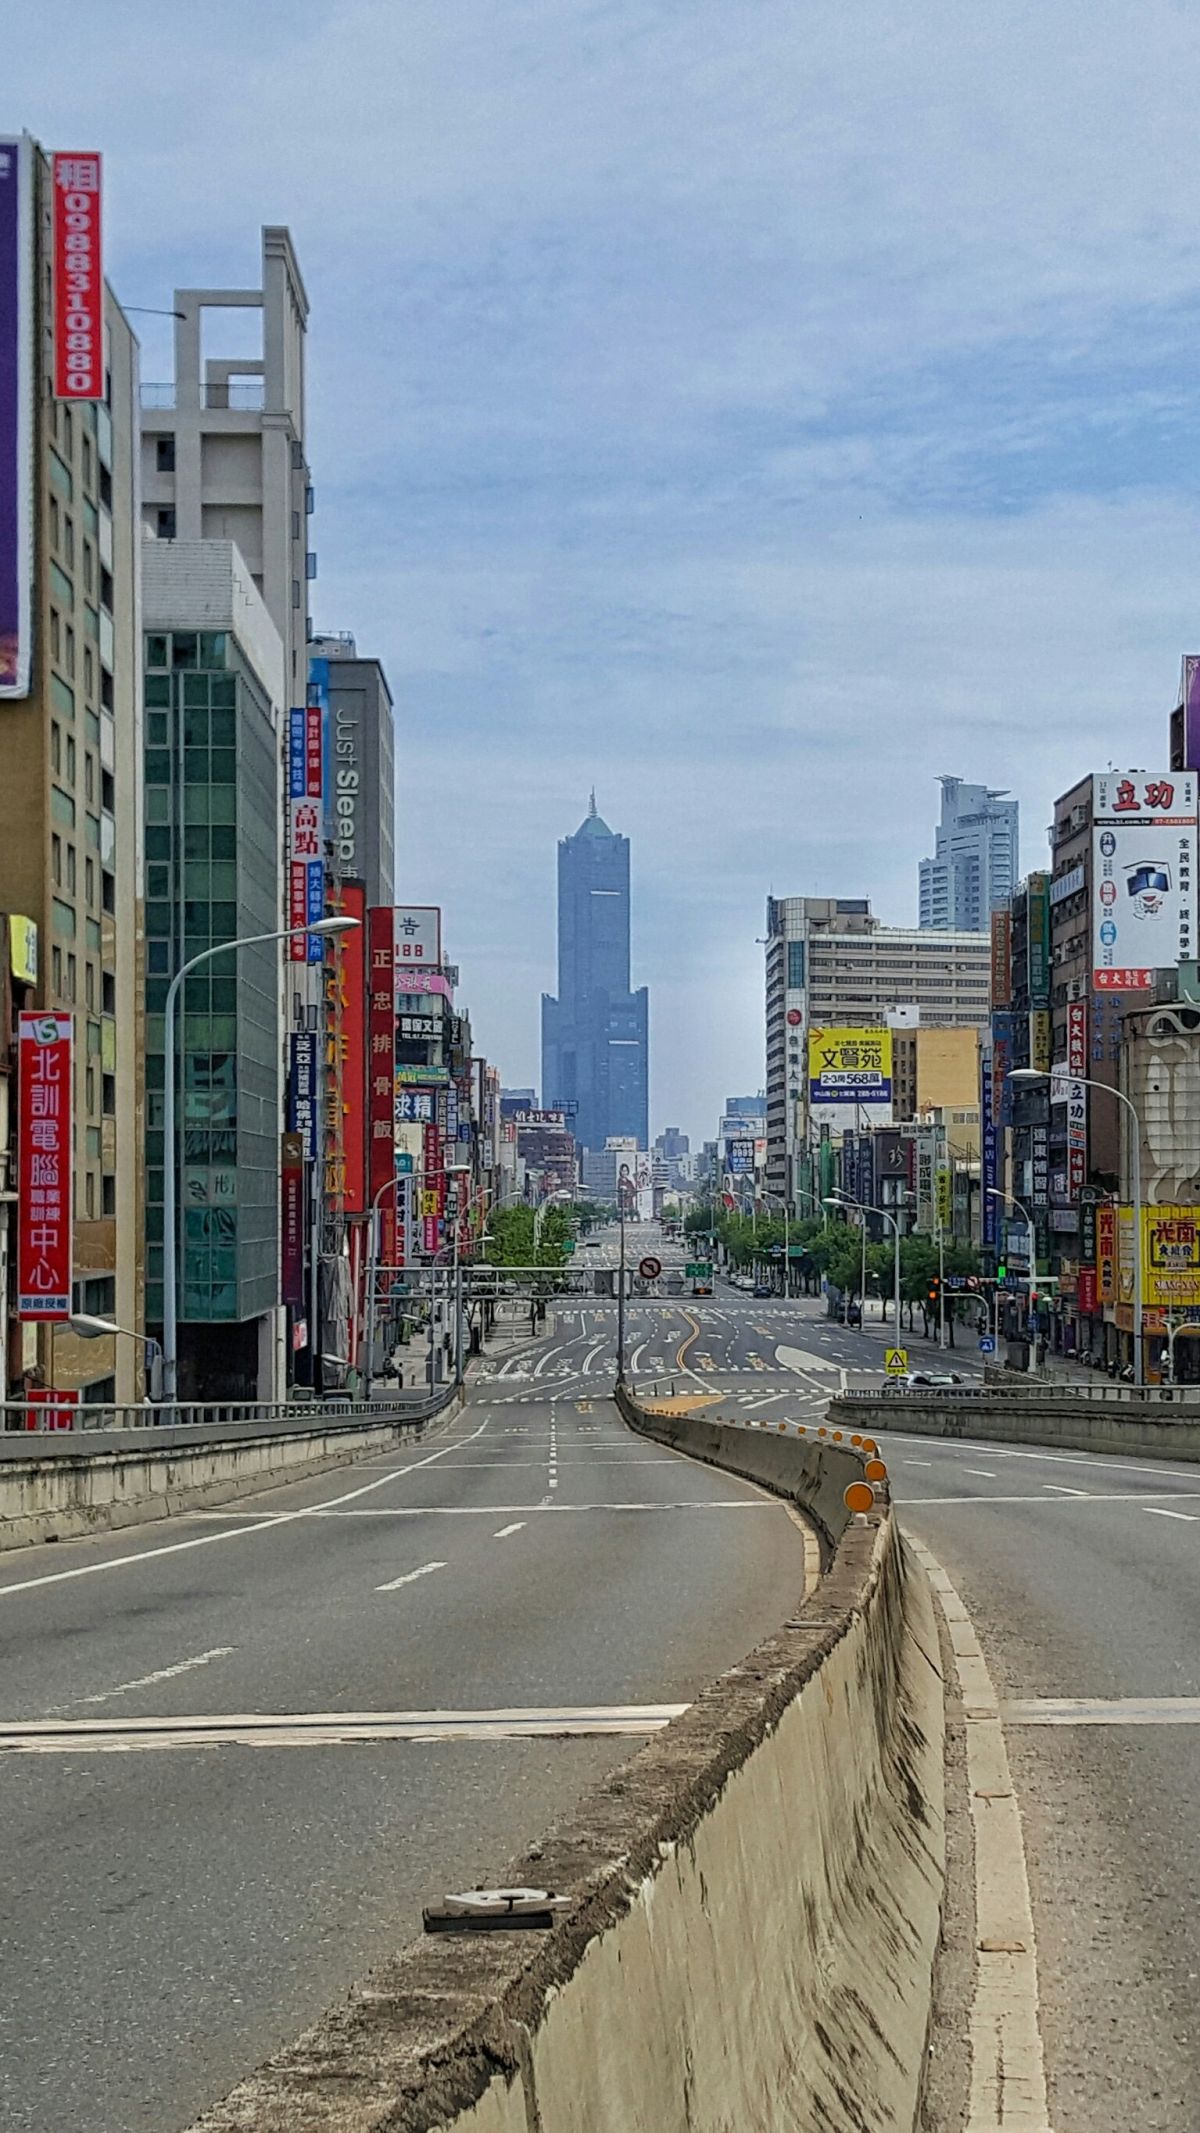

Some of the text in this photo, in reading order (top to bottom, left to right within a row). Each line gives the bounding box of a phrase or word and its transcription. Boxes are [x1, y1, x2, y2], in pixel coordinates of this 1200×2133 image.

[336, 709, 359, 766] Just
[1112, 780, 1175, 812] 立功
[294, 804, 318, 855] 高點
[336, 769, 359, 861] Sleep
[400, 917, 421, 936] 告
[372, 949, 392, 1139] 正忠排骨飯
[820, 1048, 882, 1069] 文賢苑
[395, 1095, 431, 1118] 求精
[1070, 1084, 1084, 1119] 立功
[1099, 1213, 1114, 1257] 光南
[1156, 1221, 1196, 1243] 光南
